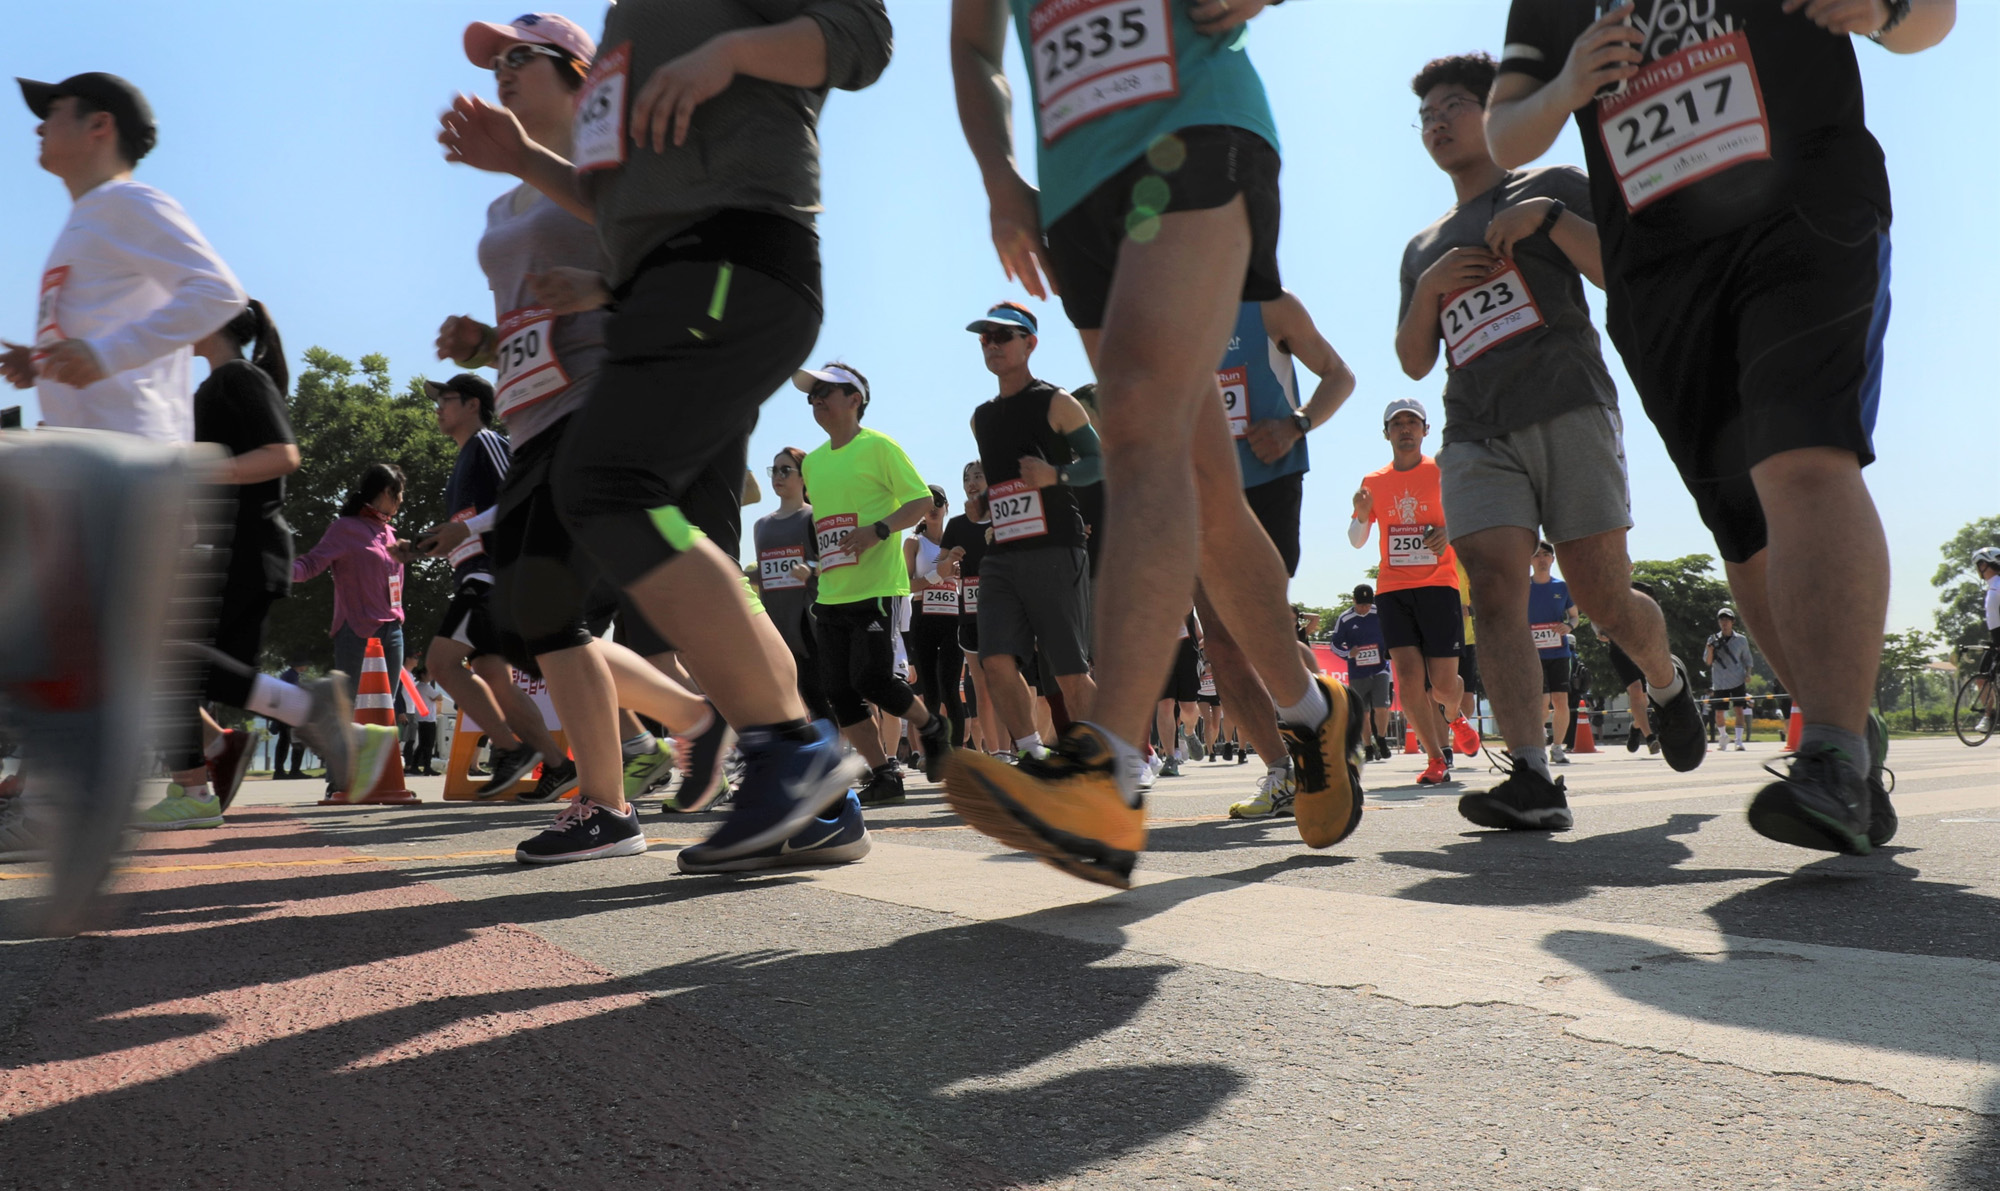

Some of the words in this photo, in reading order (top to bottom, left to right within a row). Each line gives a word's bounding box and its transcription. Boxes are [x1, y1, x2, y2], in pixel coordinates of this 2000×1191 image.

[1041, 7, 1147, 82] 2535
[1651, 13, 1734, 62] CAN
[1687, 43, 1736, 71] Run
[1617, 73, 1733, 157] 2217
[1446, 282, 1514, 335] 2123
[498, 329, 540, 379] 750
[1219, 372, 1241, 383] Run
[836, 515, 854, 524] Run
[993, 495, 1032, 520] 3027
[927, 591, 955, 602] 2465
[1357, 650, 1377, 659] 2223
